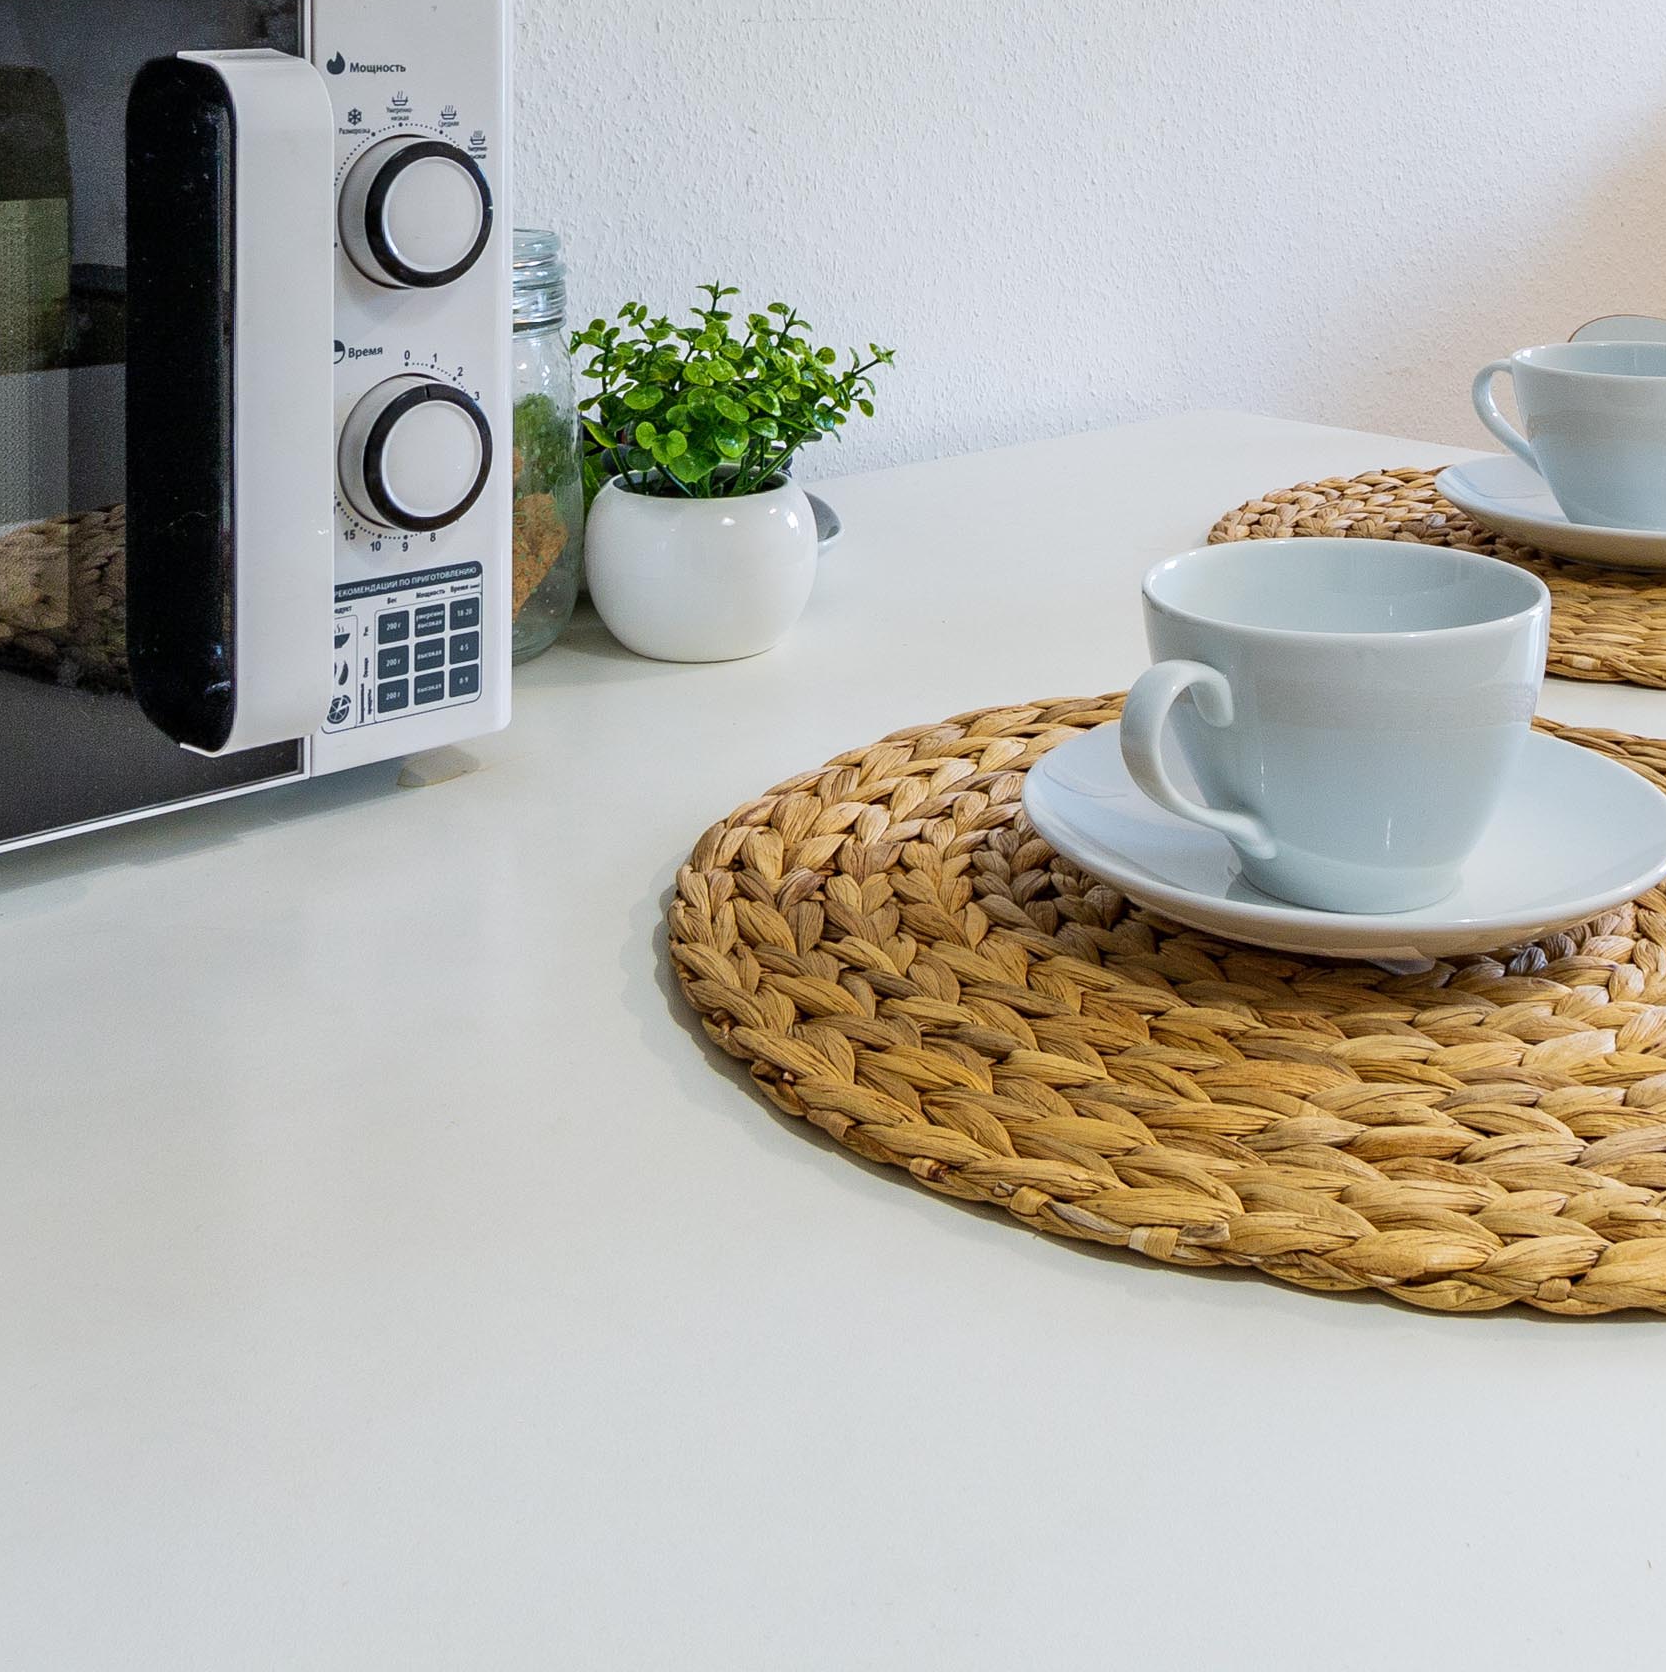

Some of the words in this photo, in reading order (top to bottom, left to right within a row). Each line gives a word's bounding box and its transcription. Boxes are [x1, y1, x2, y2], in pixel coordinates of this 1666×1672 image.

[349, 62, 407, 75] Мощность
[347, 346, 384, 360] Время
[404, 350, 411, 360] 0
[432, 353, 438, 363] 1
[457, 366, 464, 377] 2
[343, 529, 356, 541] 15
[429, 532, 436, 542] 8
[370, 541, 382, 552] 10
[402, 541, 409, 552] 9
